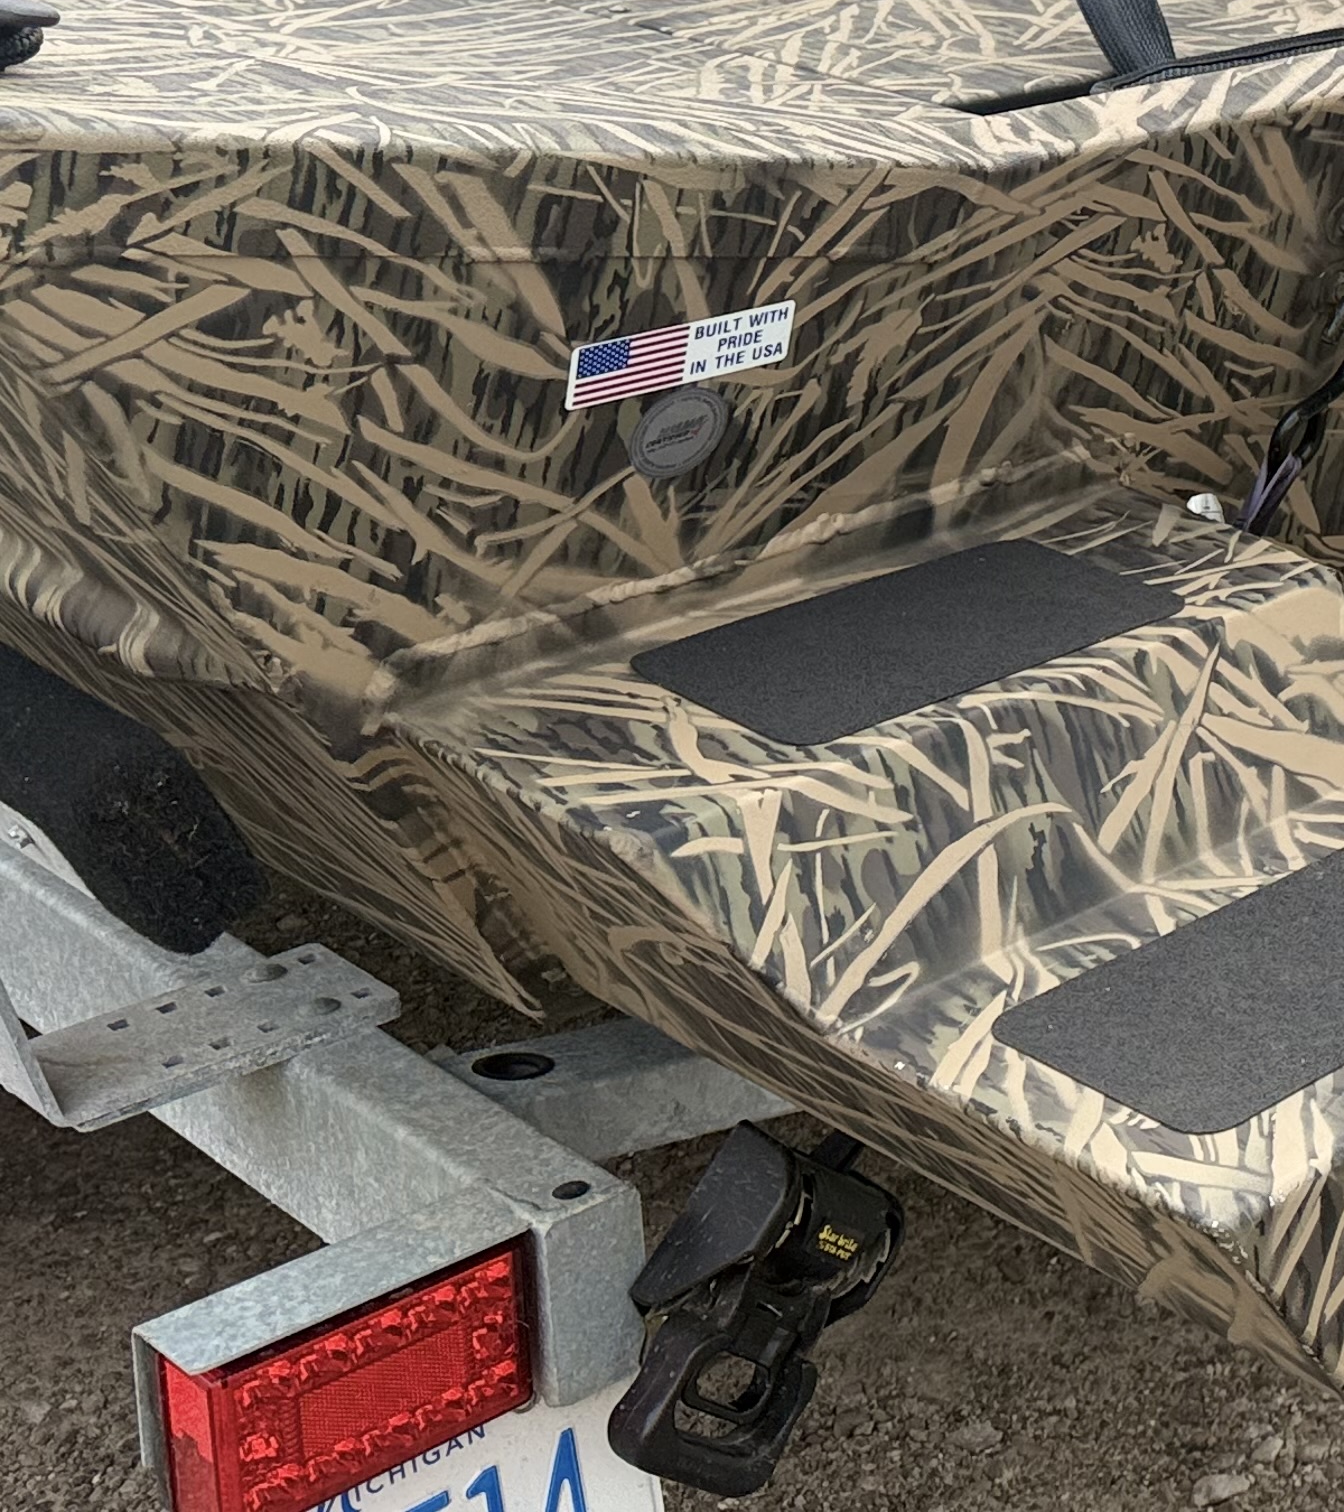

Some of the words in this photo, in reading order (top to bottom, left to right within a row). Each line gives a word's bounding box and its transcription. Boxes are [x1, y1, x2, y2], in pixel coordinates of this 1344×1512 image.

[694, 317, 743, 340] BUILT
[749, 307, 789, 328] WITH
[717, 329, 764, 352] PRIDE
[690, 359, 707, 375] IN
[715, 350, 746, 369] THE
[752, 342, 783, 361] USA
